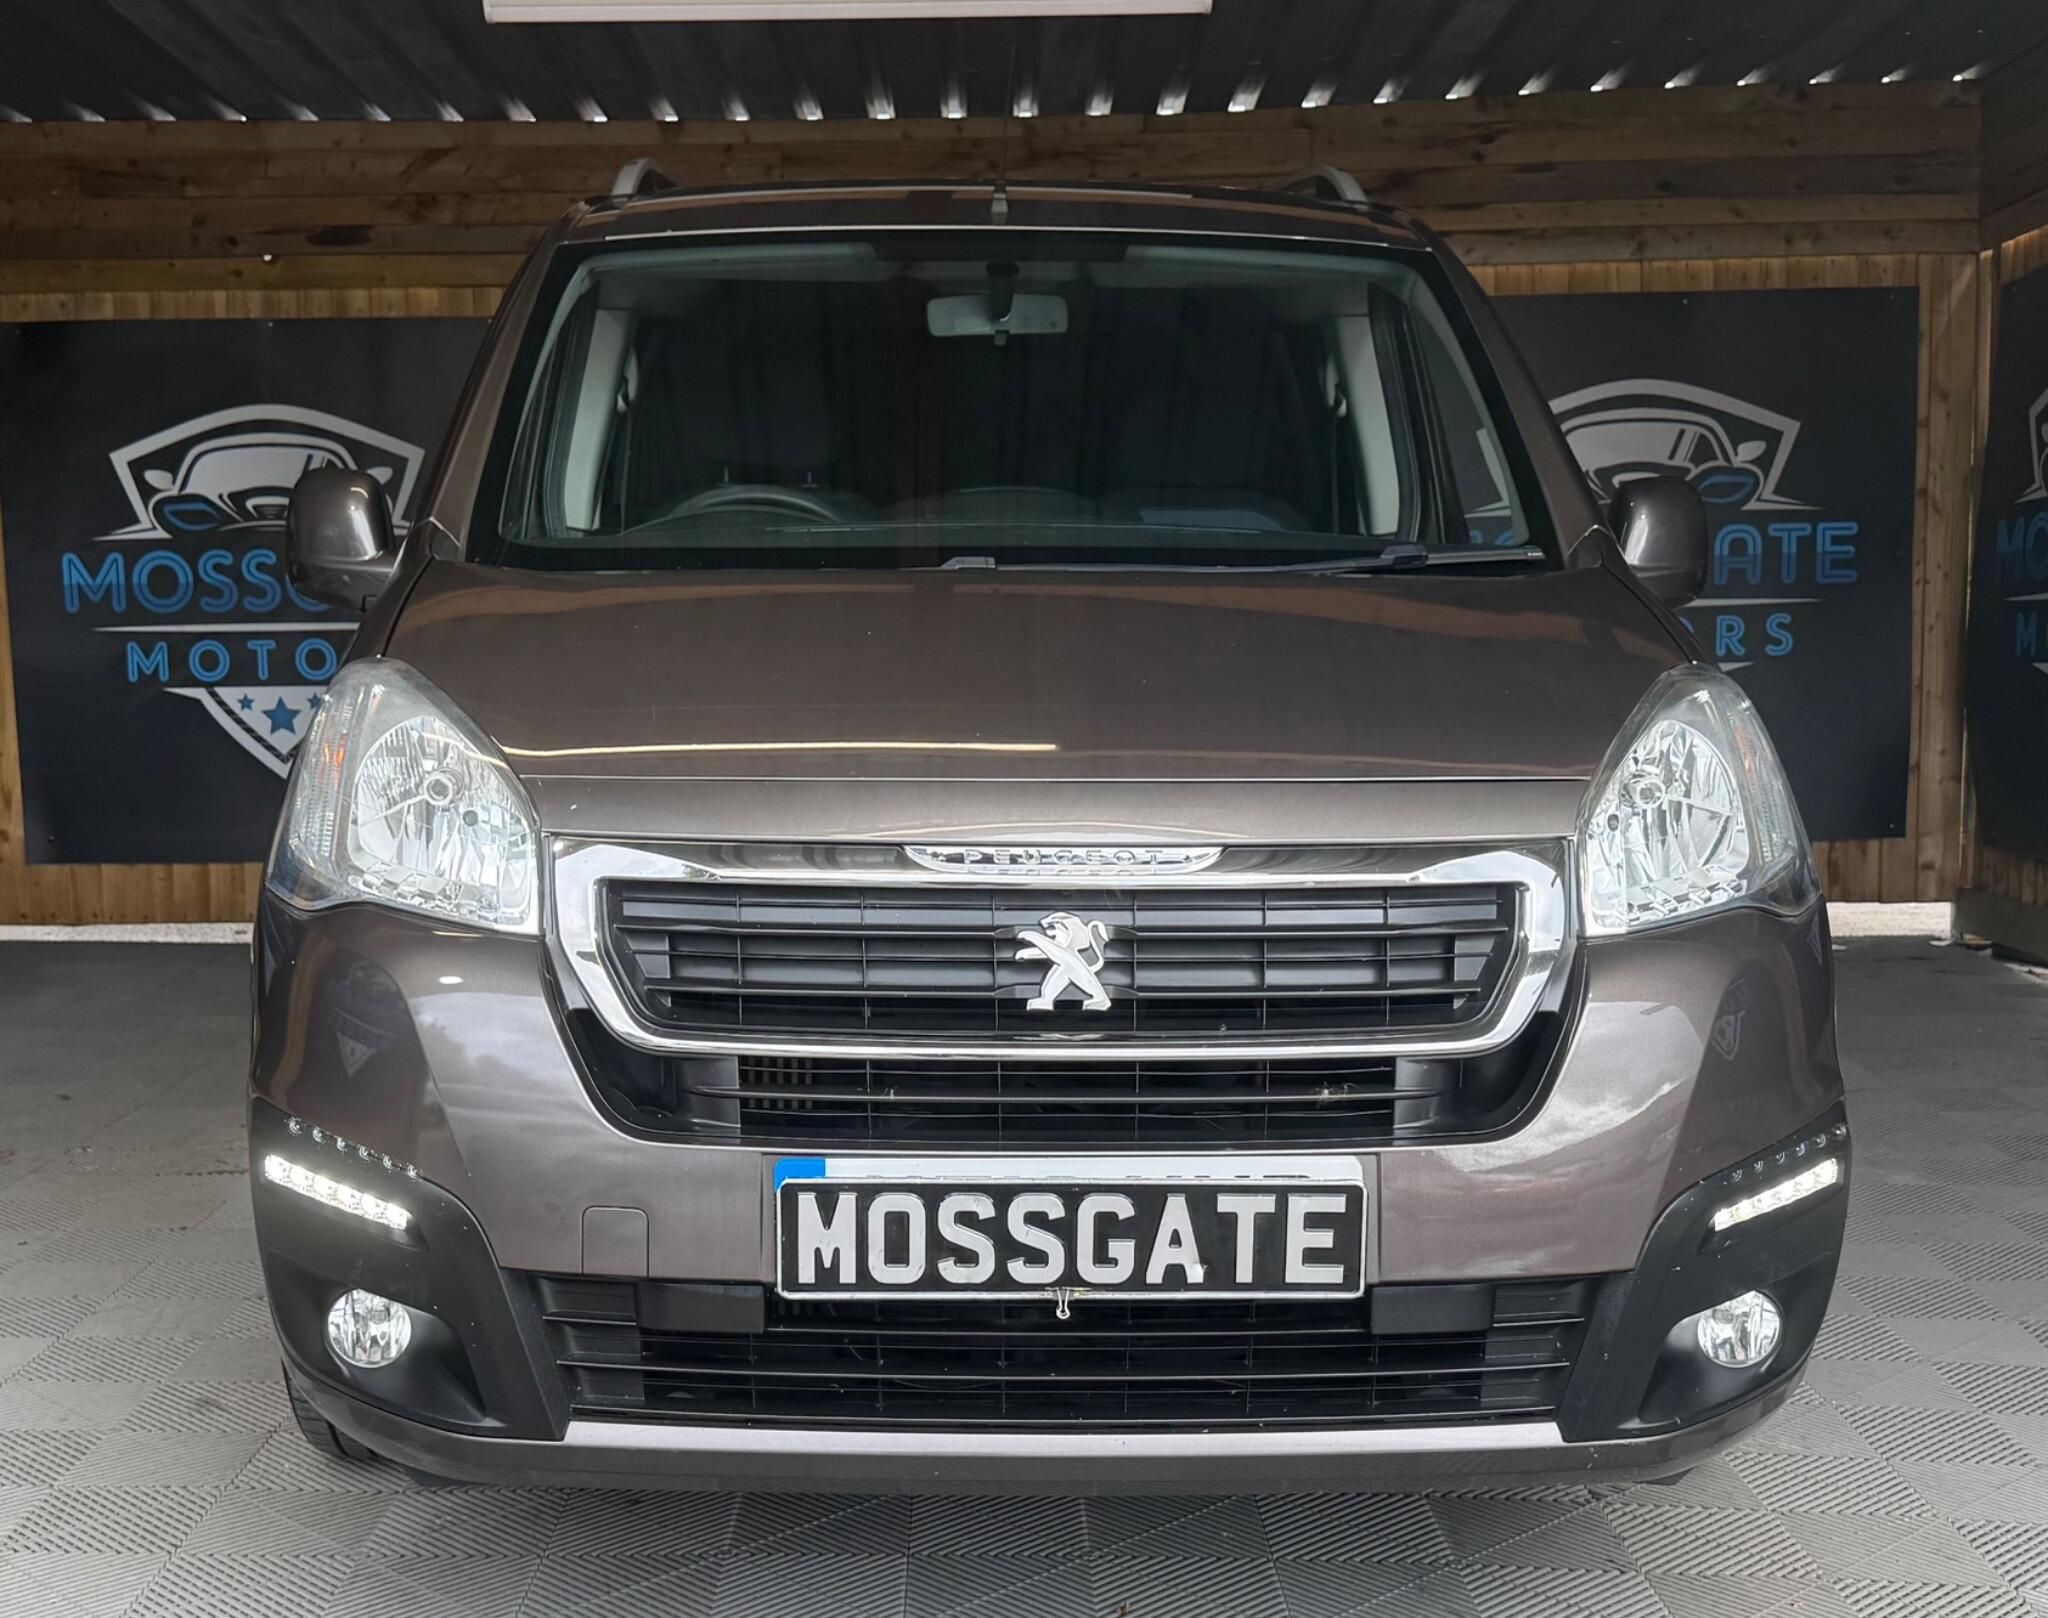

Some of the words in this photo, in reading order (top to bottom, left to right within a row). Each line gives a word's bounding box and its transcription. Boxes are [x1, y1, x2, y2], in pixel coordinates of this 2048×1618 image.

[1679, 612, 1793, 656] RS
[127, 638, 337, 683] MOTO
[963, 848, 1163, 866] PEUGEOT
[797, 1192, 1346, 1284] MOSSGATE
